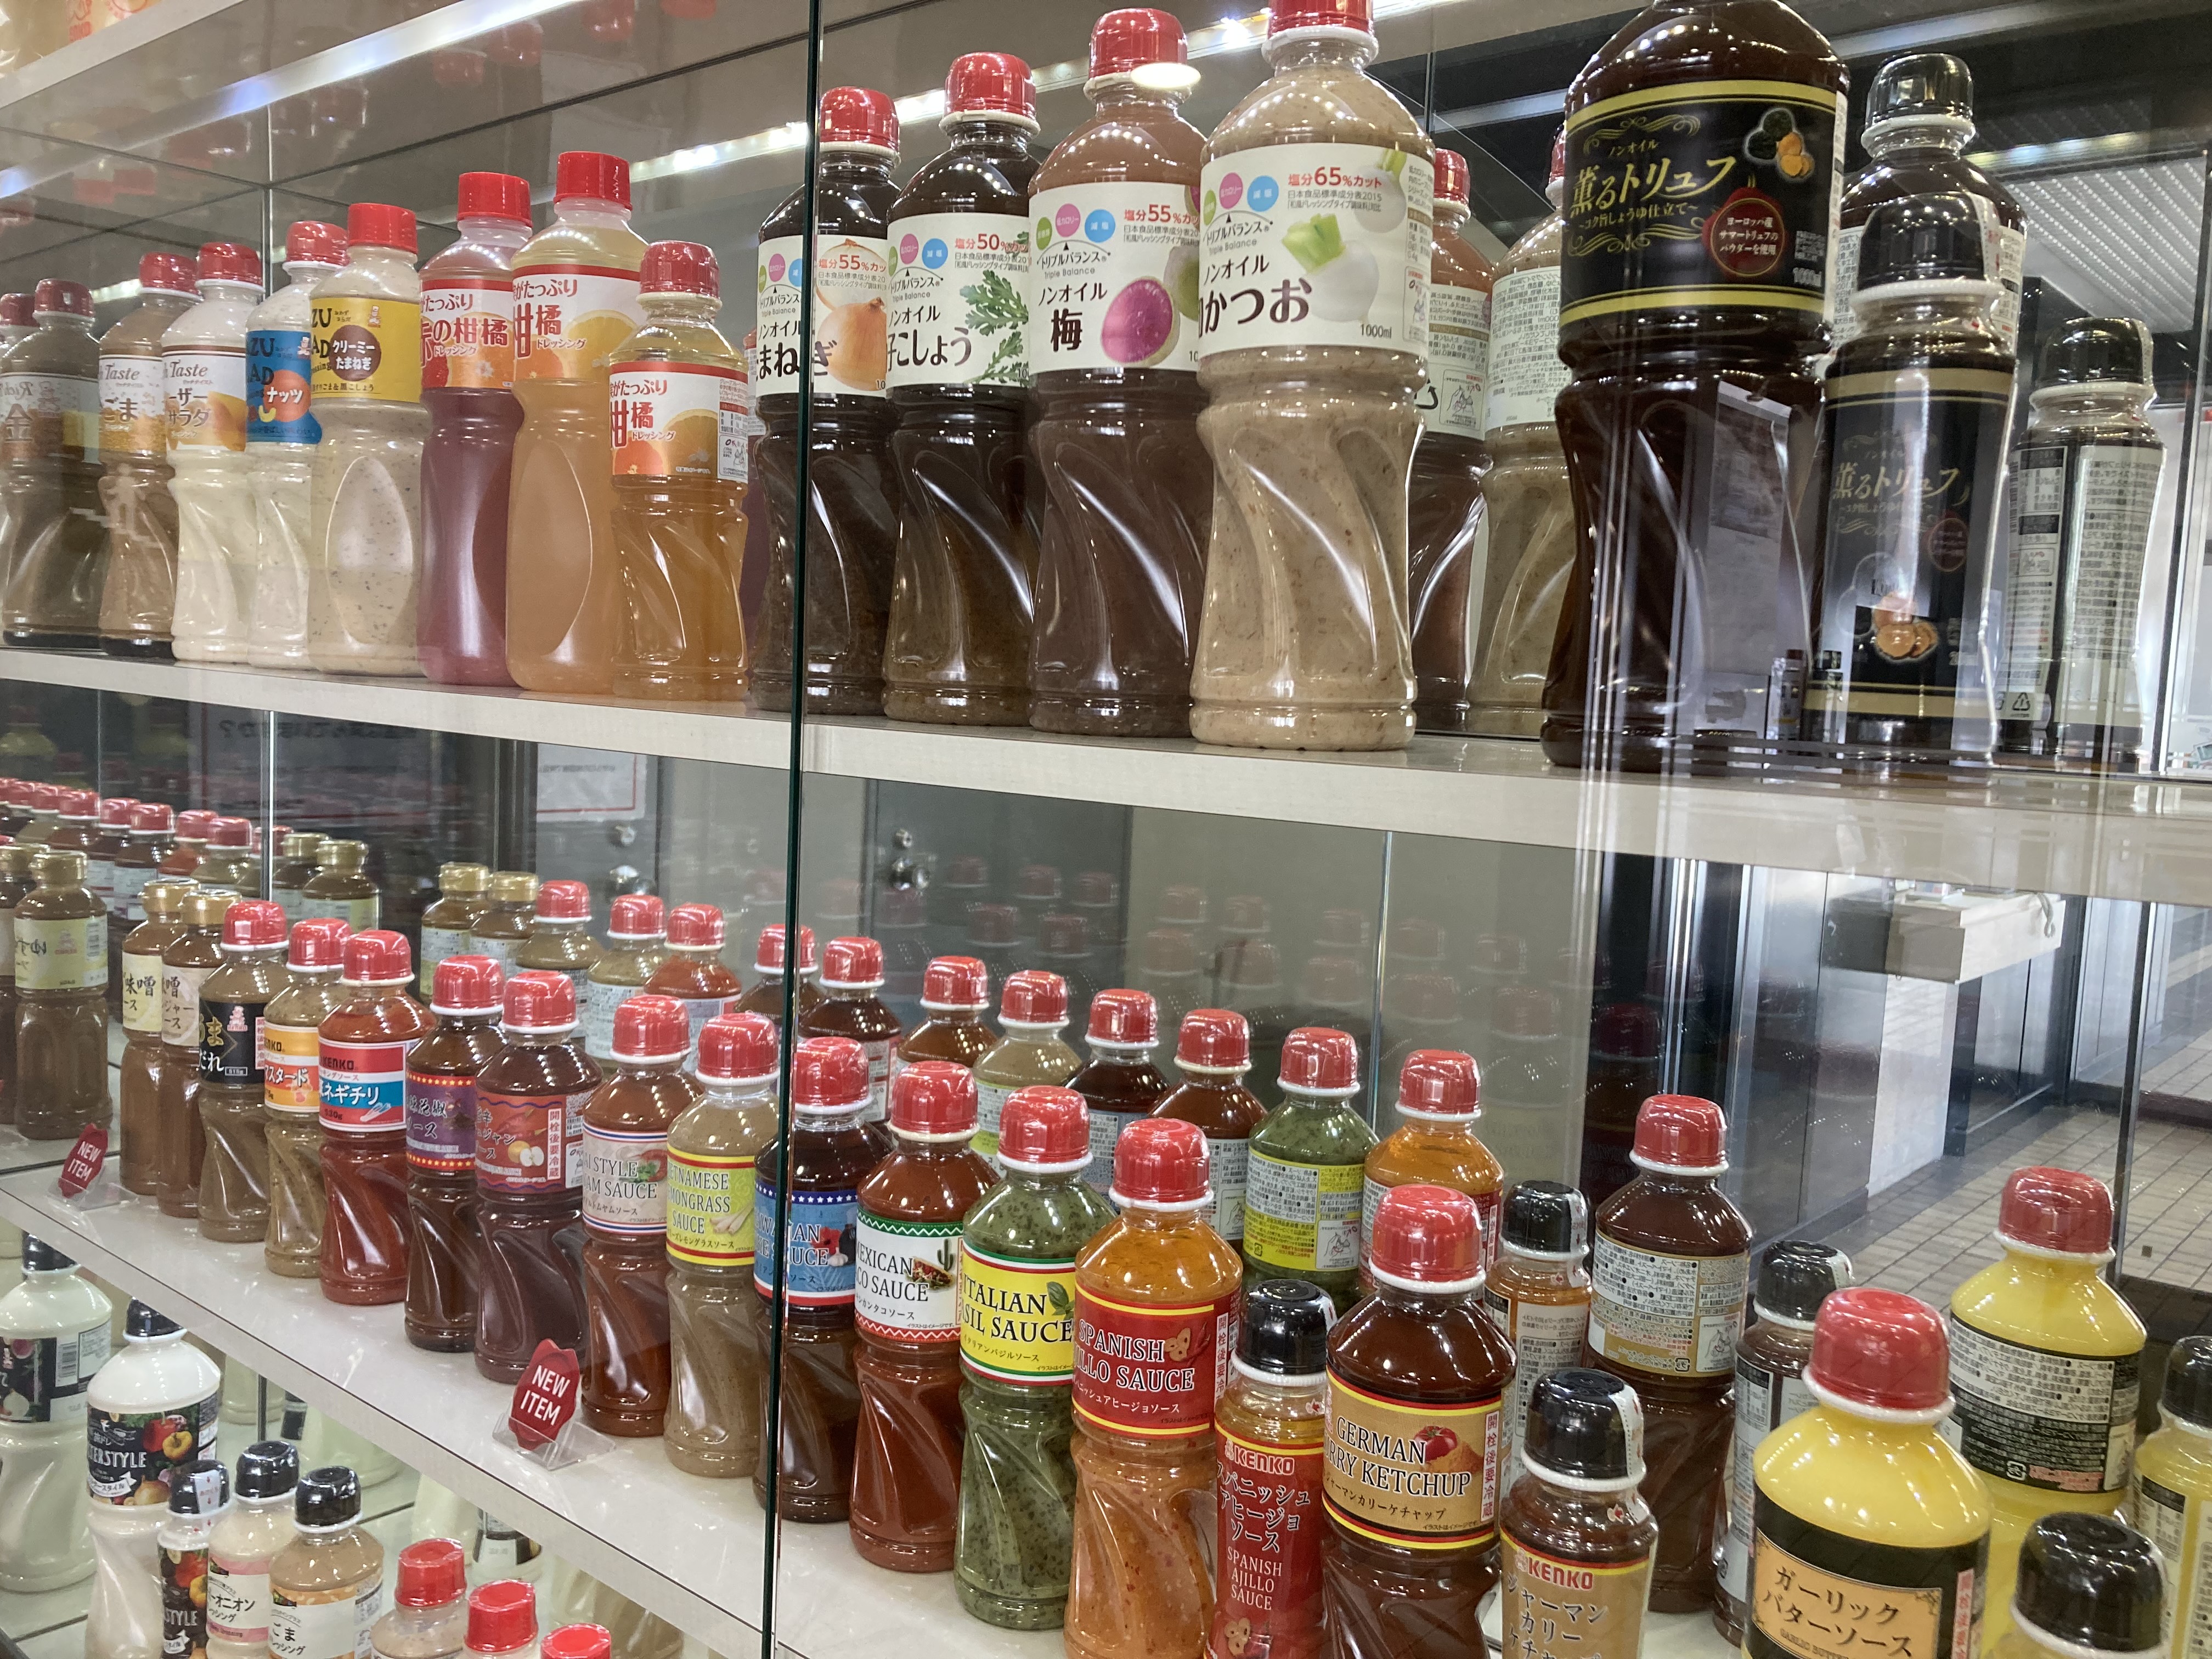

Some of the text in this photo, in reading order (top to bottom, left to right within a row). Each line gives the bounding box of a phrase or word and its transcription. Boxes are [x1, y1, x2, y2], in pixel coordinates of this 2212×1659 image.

[1609, 139, 1659, 157] ノンオイル
[1288, 166, 1383, 189] 塩分65%カット
[1570, 156, 1737, 218] 薫るトリュフ
[1288, 190, 1383, 202] 日本食品標準成分表2015
[1225, 239, 1257, 251] Balance
[1719, 229, 1779, 240] サマートリュフの
[1062, 267, 1095, 276] Balance
[1204, 253, 1269, 286] ノンオイル
[905, 291, 930, 300] Balance
[1039, 282, 1108, 307] ノンオイル
[889, 305, 940, 327] ノンオイル
[1051, 308, 1083, 352] 梅
[1361, 324, 1392, 339] 1000ml
[332, 340, 376, 354] クリーミー
[433, 344, 477, 357] ドレッシング
[537, 338, 587, 350] ドレッシング
[105, 363, 140, 381] Taste
[170, 359, 208, 379] Taste
[336, 357, 372, 371] たまねぎ
[267, 386, 303, 404] ナッツ
[631, 431, 676, 441] ドレッシング
[162, 977, 181, 998] 噌
[323, 1057, 356, 1071] KENKO
[77, 1141, 102, 1163] NEW
[549, 1110, 562, 1178] 開栓後要冷蔵
[67, 1158, 93, 1182] ITEM
[593, 1156, 639, 1177] STYLE
[605, 1181, 657, 1199] SAUCE
[673, 1210, 706, 1234] SAUCE
[871, 1274, 929, 1302] SAUCE
[964, 1273, 1048, 1316] ITALIAN
[991, 1316, 1073, 1343] SAUCE
[1079, 1318, 1166, 1363] SPANISH
[963, 1333, 1039, 1363] イタリアンバジルソース
[1216, 1317, 1228, 1399] 開栓後要冷
[532, 1364, 571, 1398] NEW
[1116, 1365, 1195, 1392] SAUCE
[520, 1390, 562, 1426] ITEM
[1337, 1415, 1426, 1465] GERMAN
[1234, 1447, 1295, 1476] KENKO
[1483, 1413, 1499, 1517] 開栓後要冷蔵
[1217, 1461, 1311, 1506] スパニッシュ
[1361, 1458, 1471, 1499] KETCHUP
[1220, 1486, 1300, 1532] アヒージョ
[1231, 1520, 1280, 1554] ソース
[1227, 1545, 1283, 1577] SPANISH
[1527, 1556, 1594, 1591] KENKO
[1231, 1566, 1275, 1593] AJILLO
[1231, 1584, 1273, 1612] SAUCE
[1508, 1572, 1609, 1624] ジャーマン
[1774, 1566, 1899, 1626] ガーリック
[1520, 1611, 1582, 1644] カリー
[1763, 1589, 1912, 1658] バターソース
